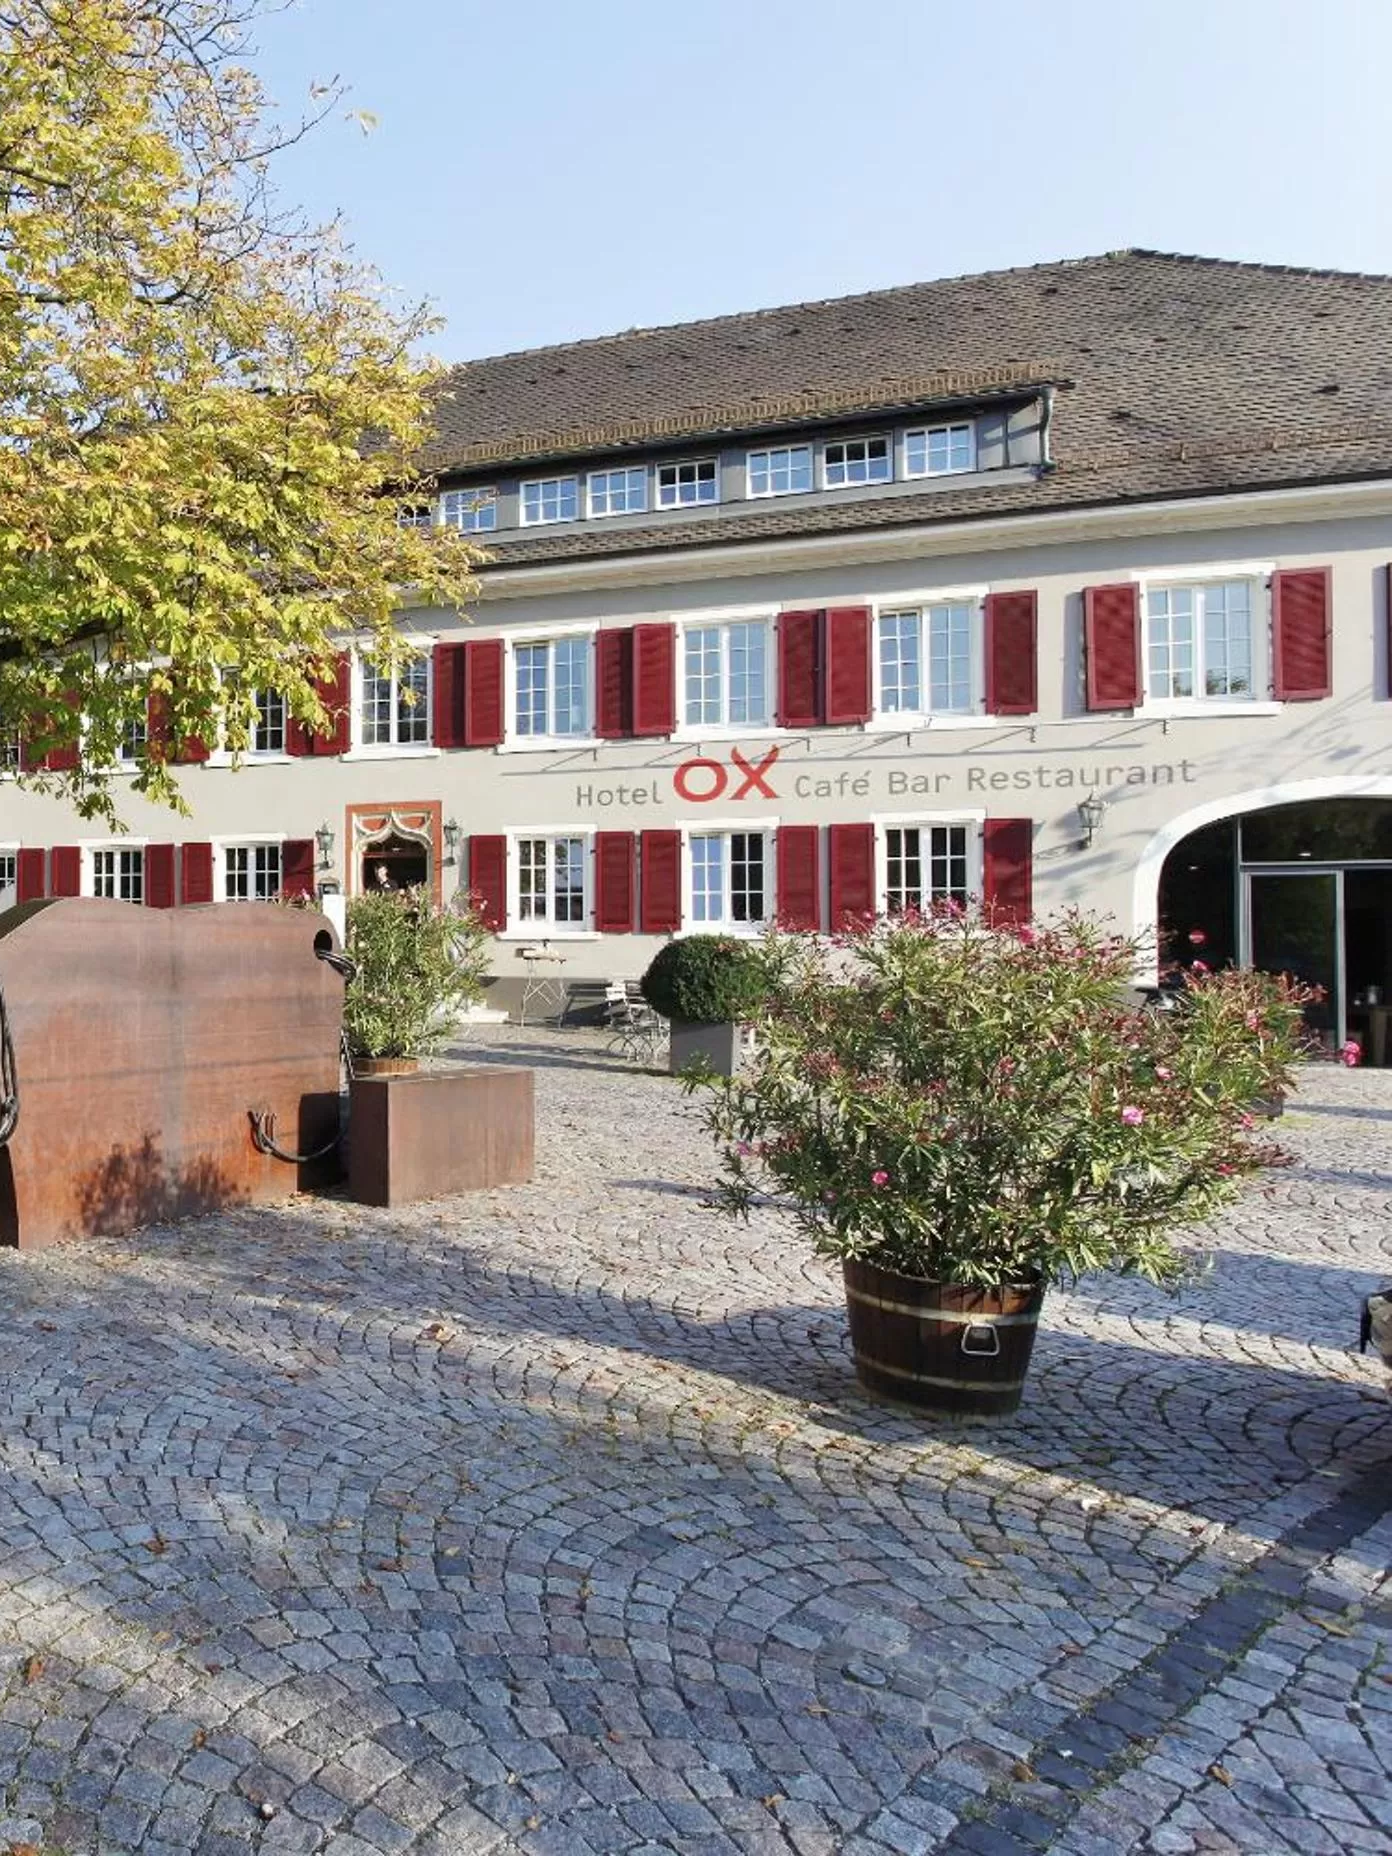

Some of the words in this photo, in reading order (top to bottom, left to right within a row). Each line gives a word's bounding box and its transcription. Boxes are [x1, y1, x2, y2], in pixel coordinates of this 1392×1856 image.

[576, 780, 664, 807] Hotel
[673, 743, 781, 803] OX
[795, 769, 872, 798] Café
[888, 771, 951, 795] Bar
[967, 759, 1196, 791] Restaurant
